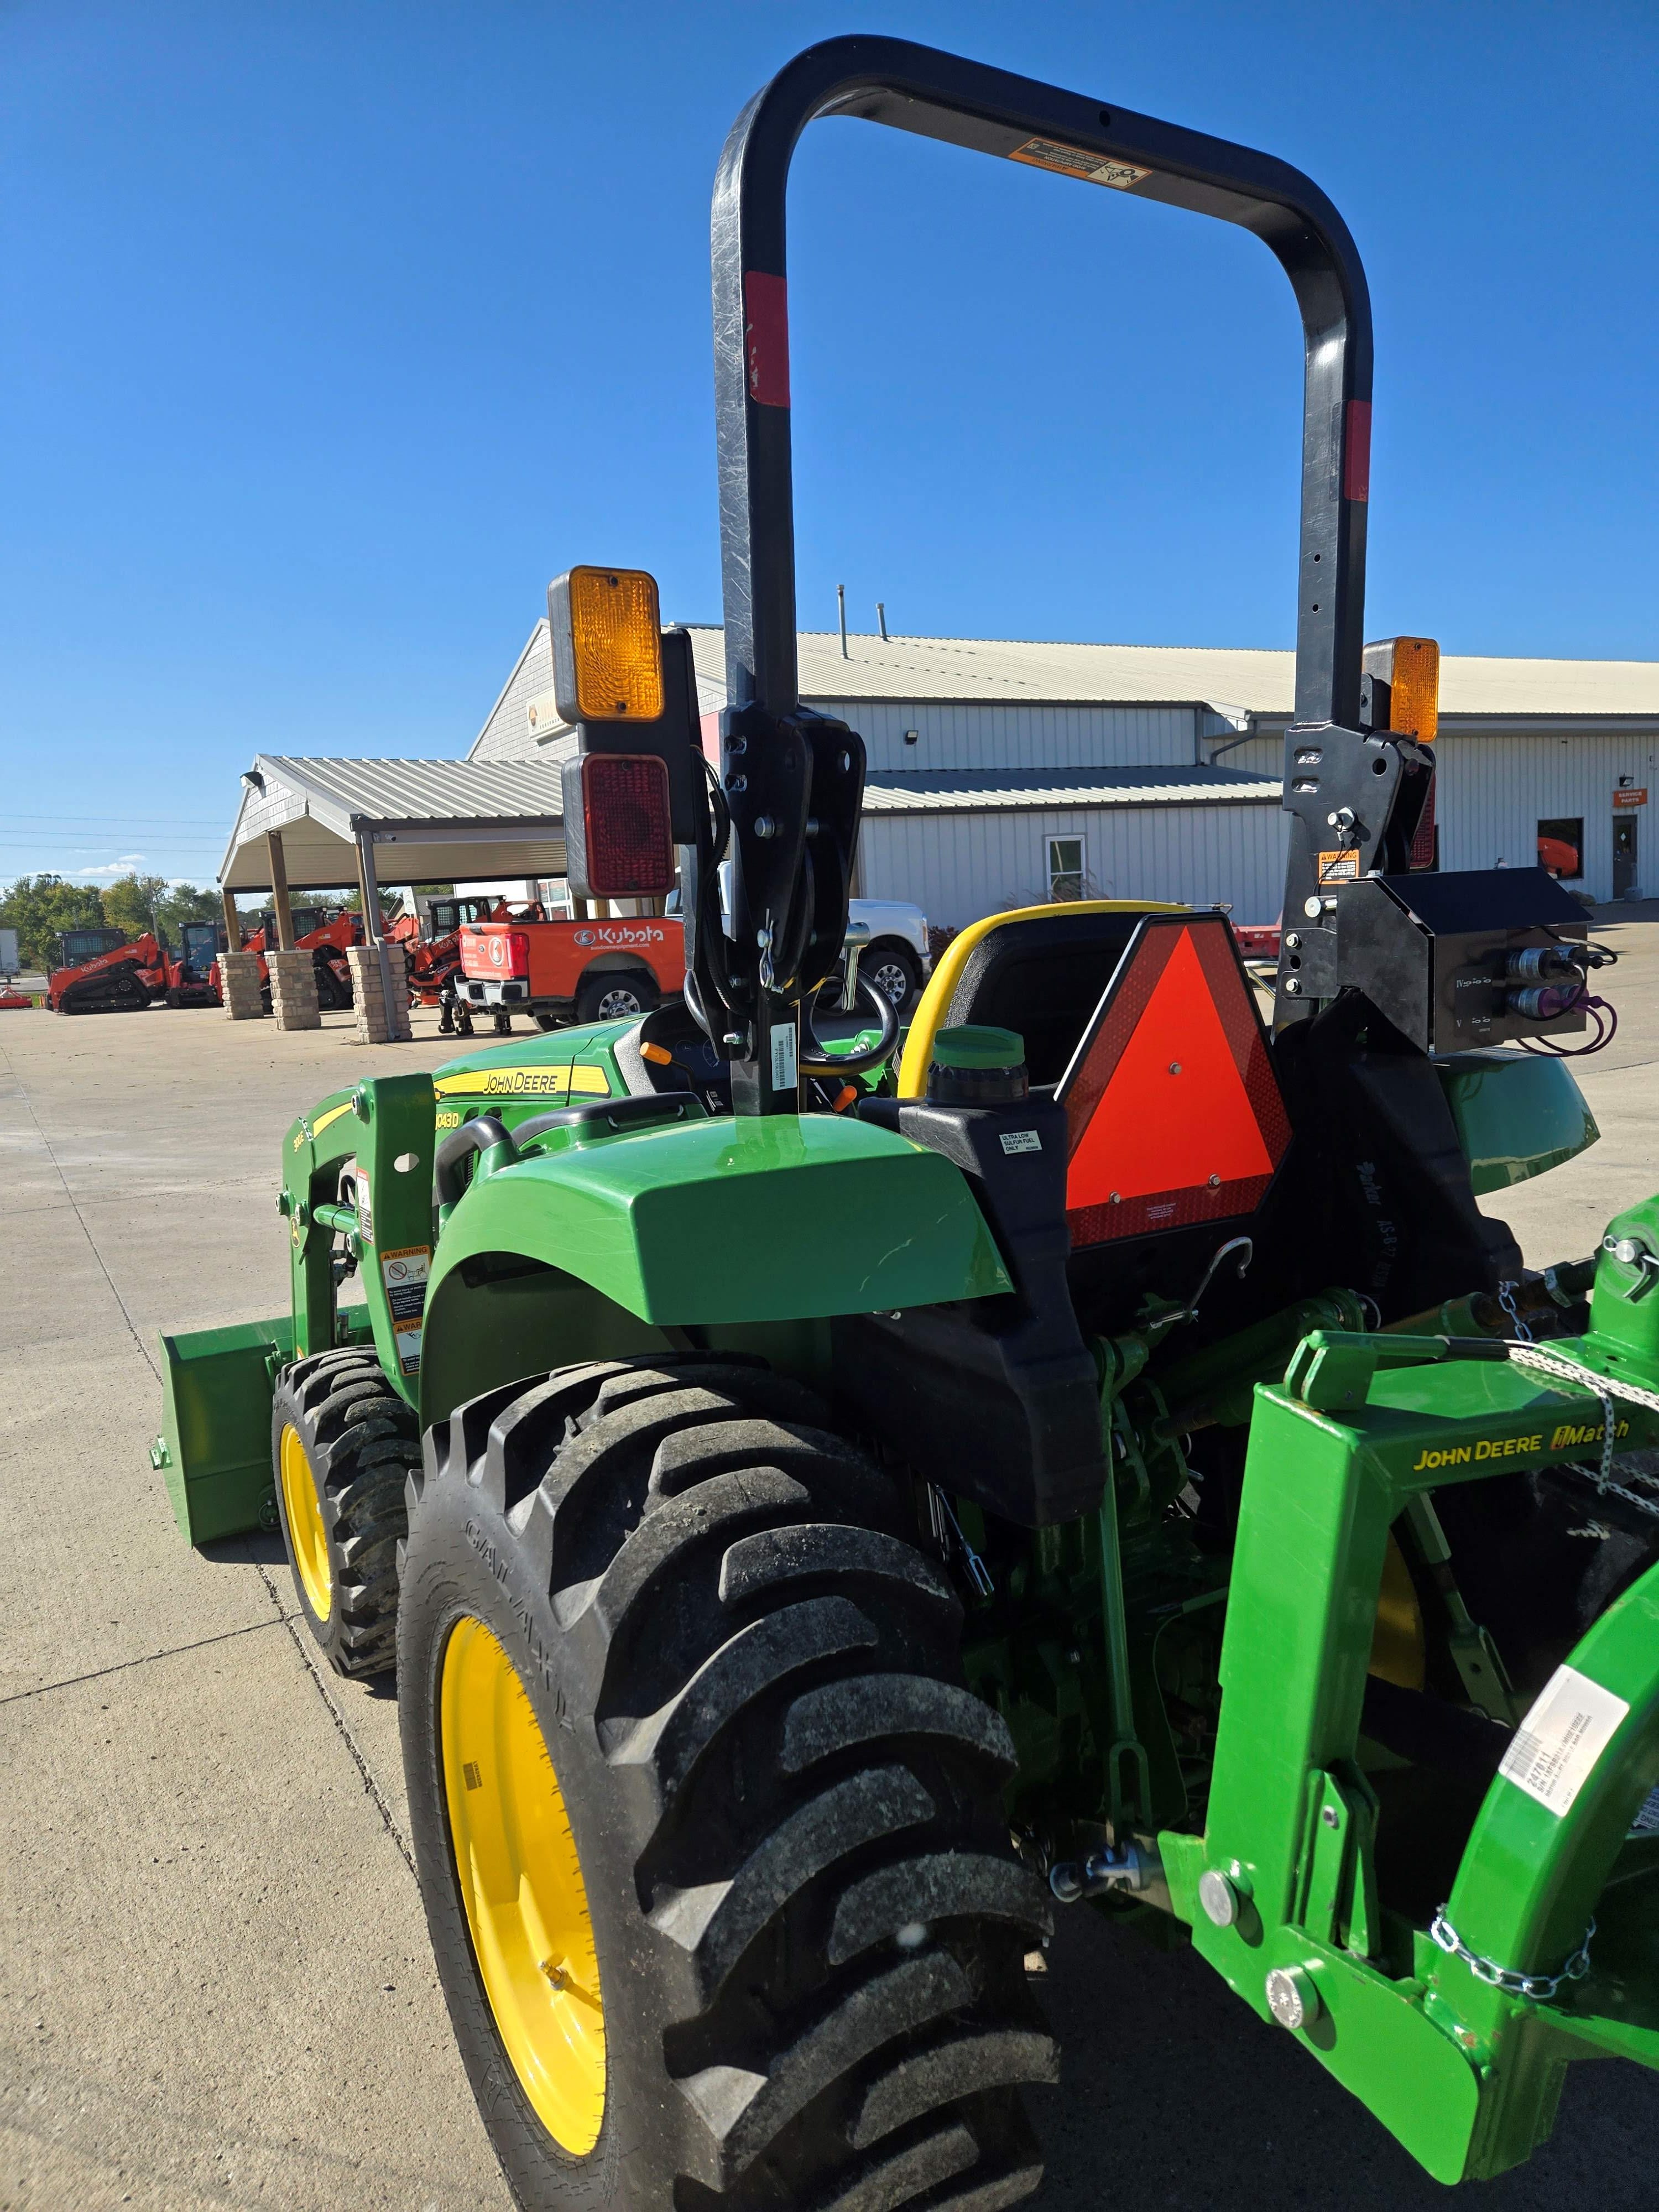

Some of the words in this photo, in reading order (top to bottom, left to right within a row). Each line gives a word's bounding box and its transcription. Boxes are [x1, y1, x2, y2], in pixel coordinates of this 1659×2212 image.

[439, 933, 459, 949] Kubot
[598, 926, 664, 943] Kubota
[80, 959, 108, 973] Kubota
[483, 1073, 514, 1092] JOHN
[514, 1072, 558, 1091] DEERE
[390, 1246, 427, 1258] WARNING
[1413, 1446, 1472, 1470] JOHN
[1474, 1434, 1543, 1460] DEERE
[1551, 1420, 1629, 1450] iMath
